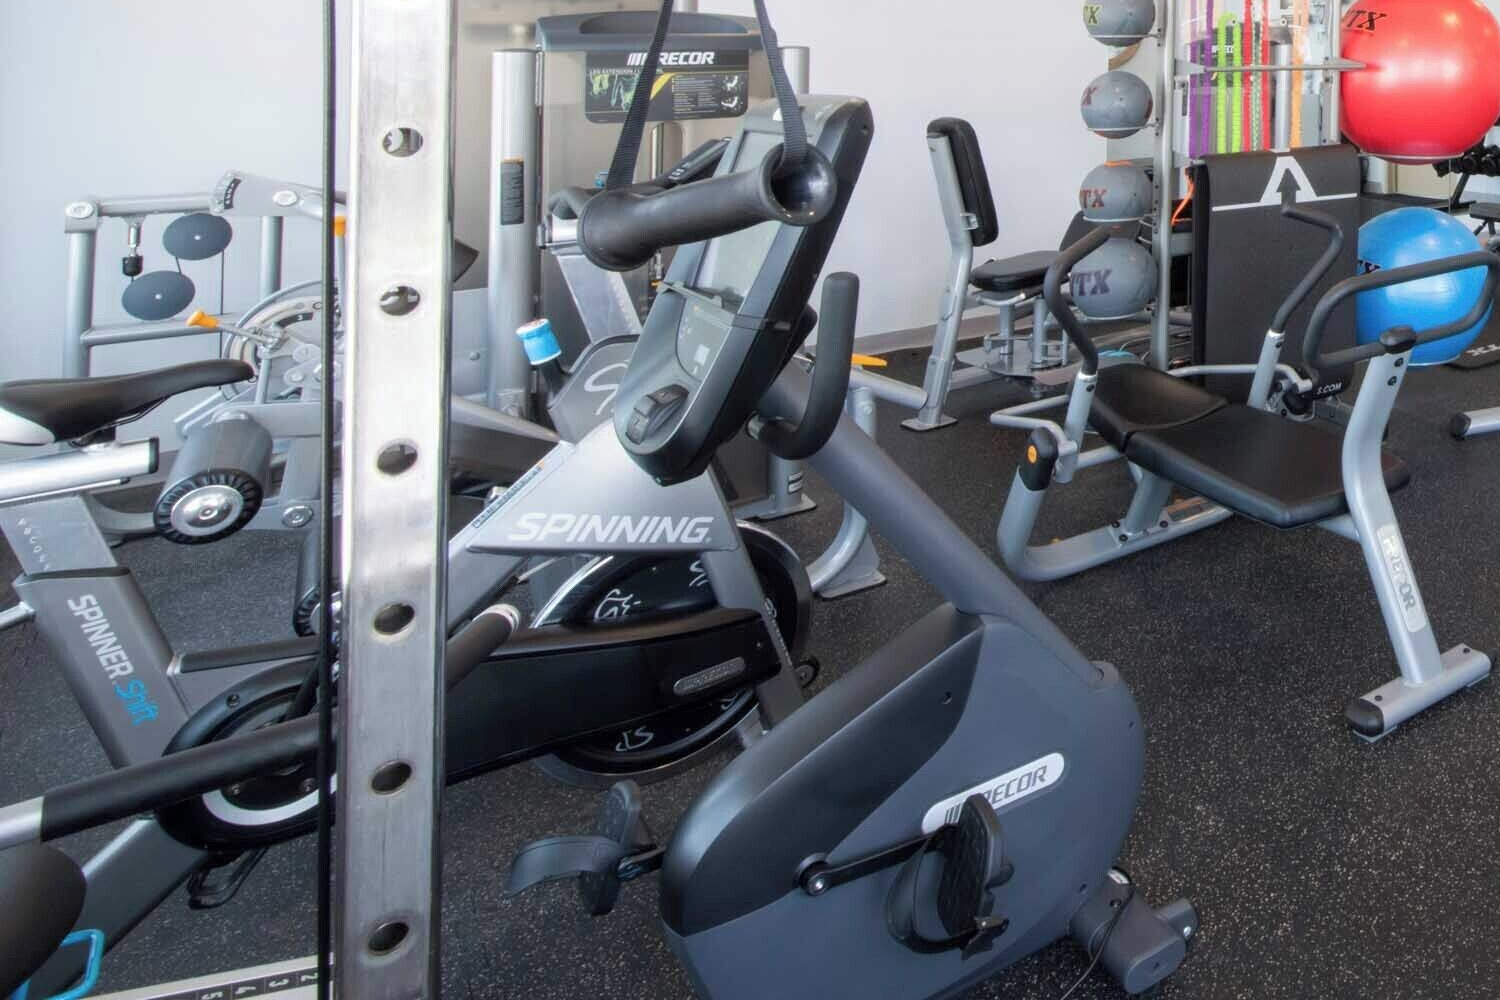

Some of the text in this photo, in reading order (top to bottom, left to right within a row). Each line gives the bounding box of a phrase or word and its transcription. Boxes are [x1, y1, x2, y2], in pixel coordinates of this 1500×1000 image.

[508, 512, 714, 544] SPINNING
[66, 594, 159, 726] SPINNER Shift
